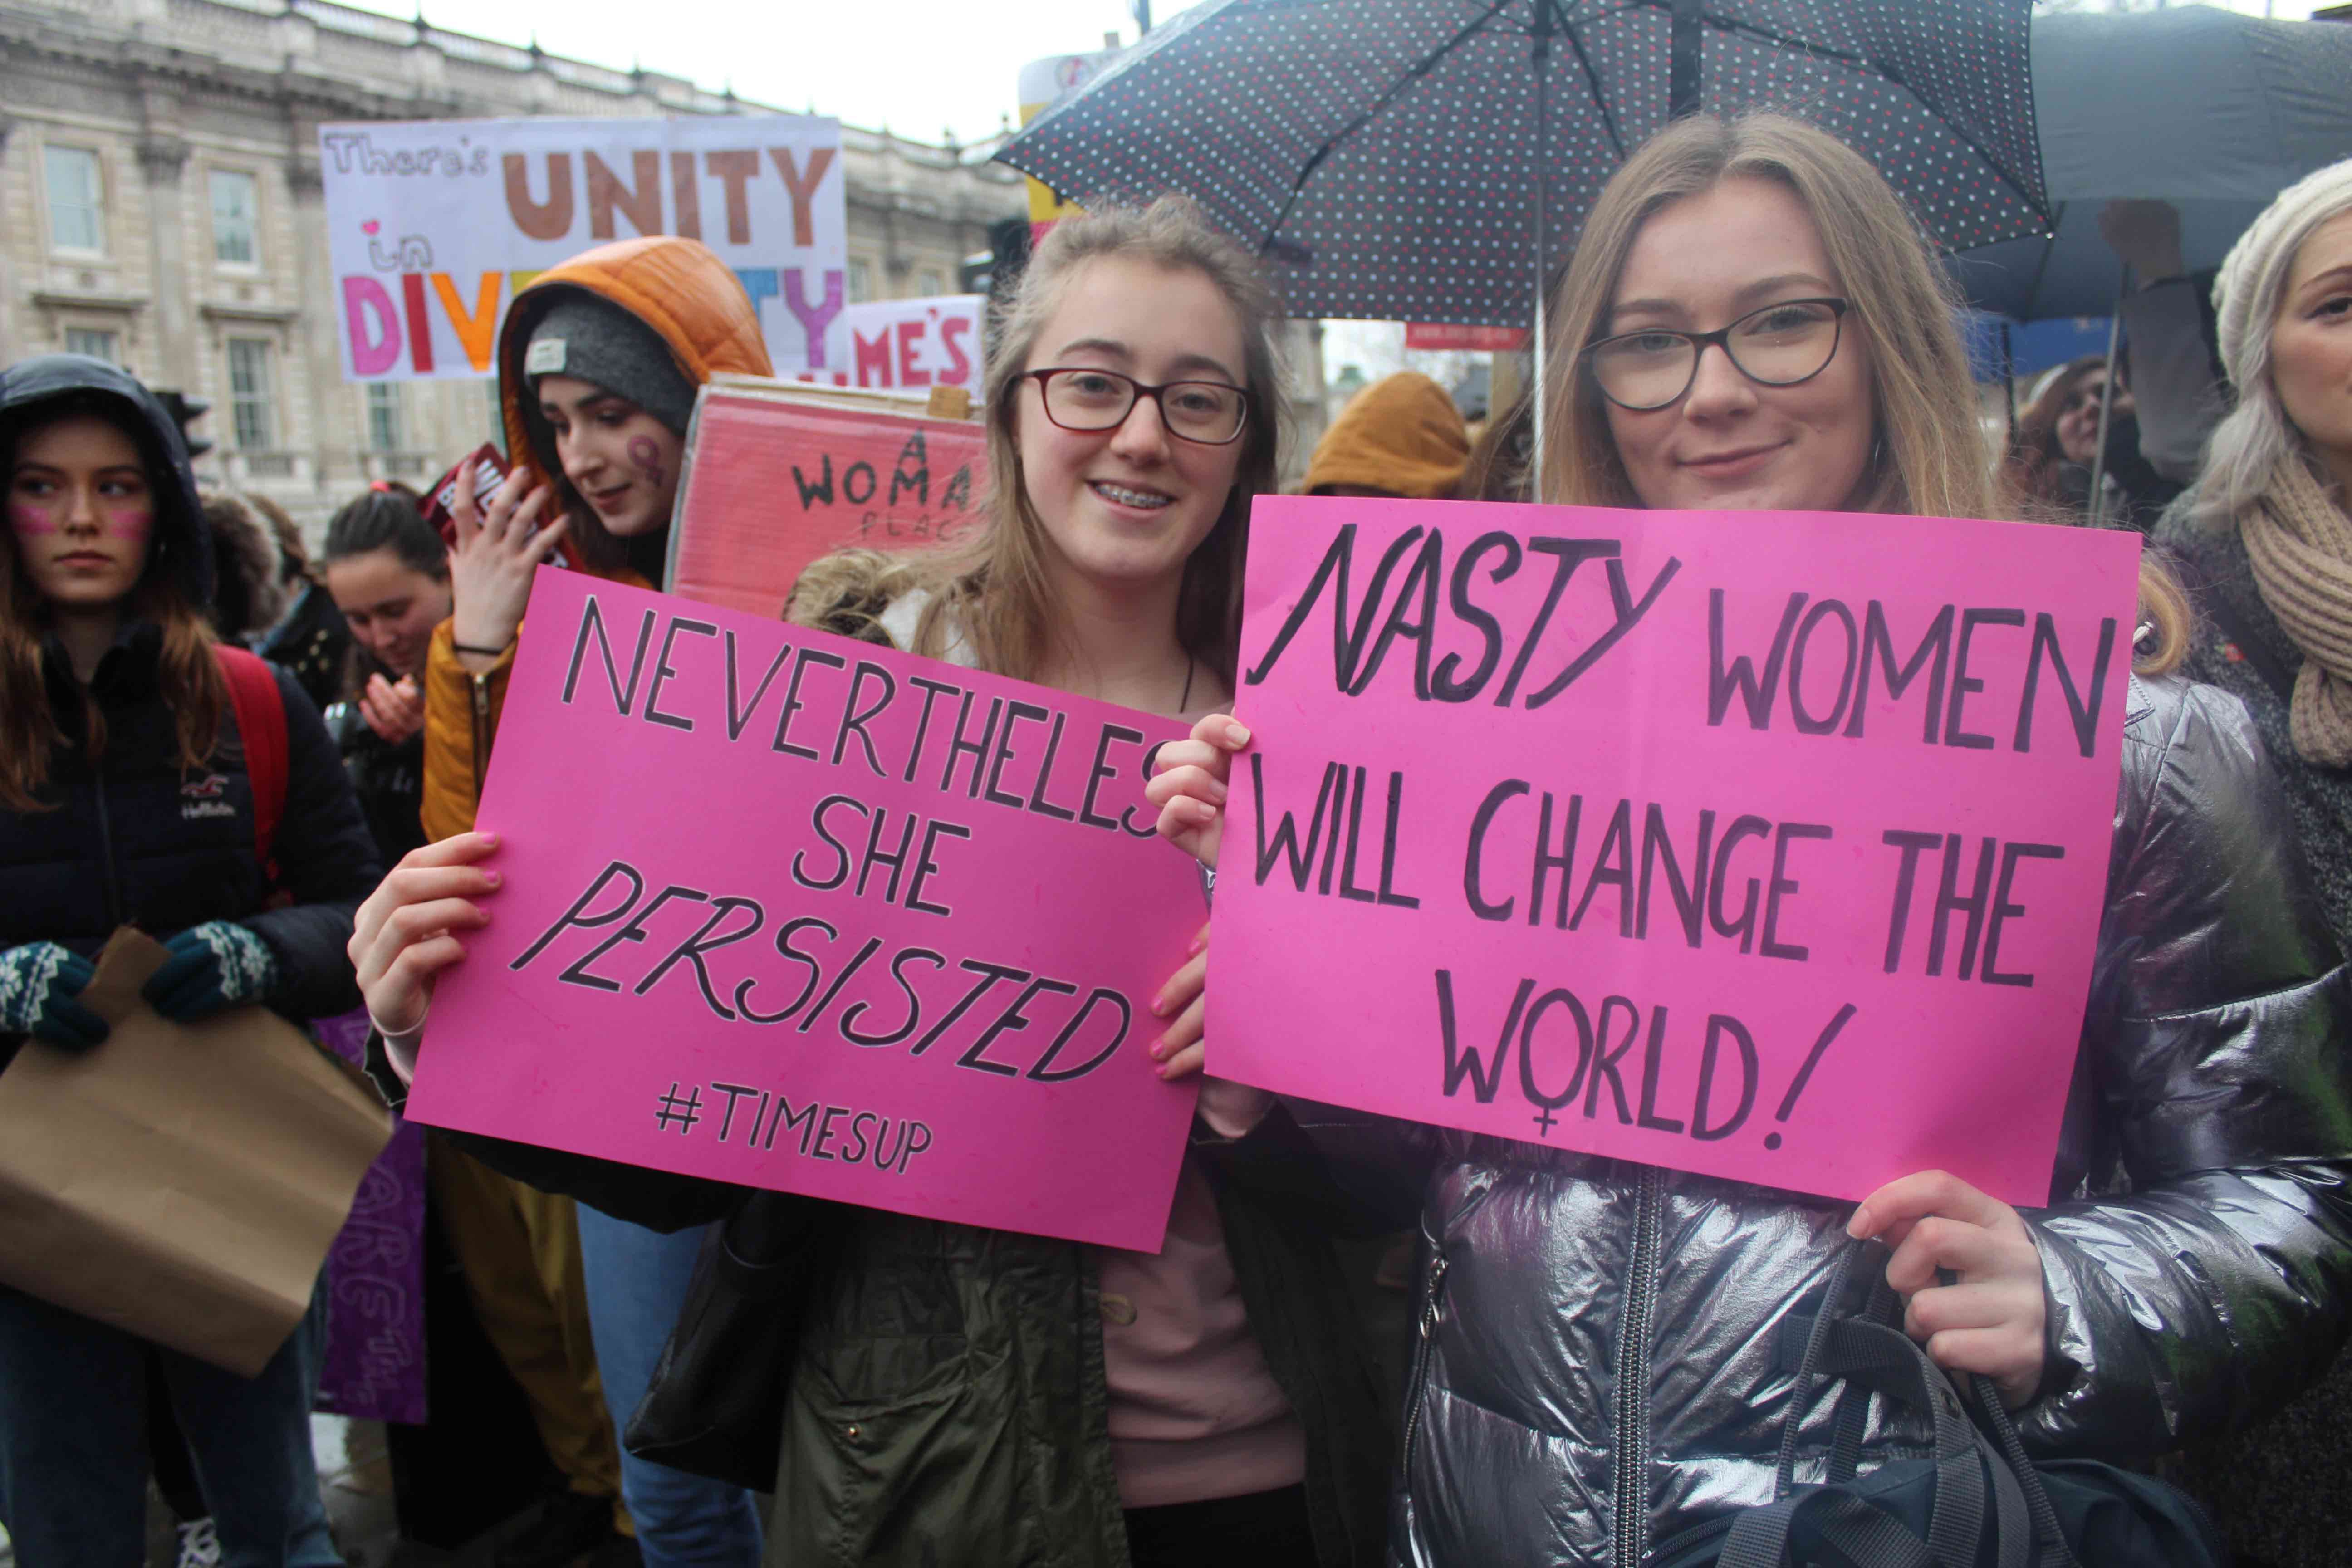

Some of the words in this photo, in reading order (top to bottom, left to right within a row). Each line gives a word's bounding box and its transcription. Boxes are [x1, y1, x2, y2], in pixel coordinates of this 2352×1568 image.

[323, 131, 490, 177] There's
[502, 147, 836, 246] UNITY
[362, 220, 434, 272] in
[791, 453, 972, 512] WOMA
[1245, 522, 1682, 710] NASTY
[1707, 588, 2117, 758] WOMEN
[791, 794, 971, 917] SHE
[1251, 753, 1420, 909] WILL
[1464, 779, 1832, 961] CHANGE
[1883, 829, 2065, 987] THE
[509, 860, 1132, 1084] PERSISTED
[1436, 969, 1857, 1150] WORLD!
[655, 1082, 933, 1175] #TIMESUP
